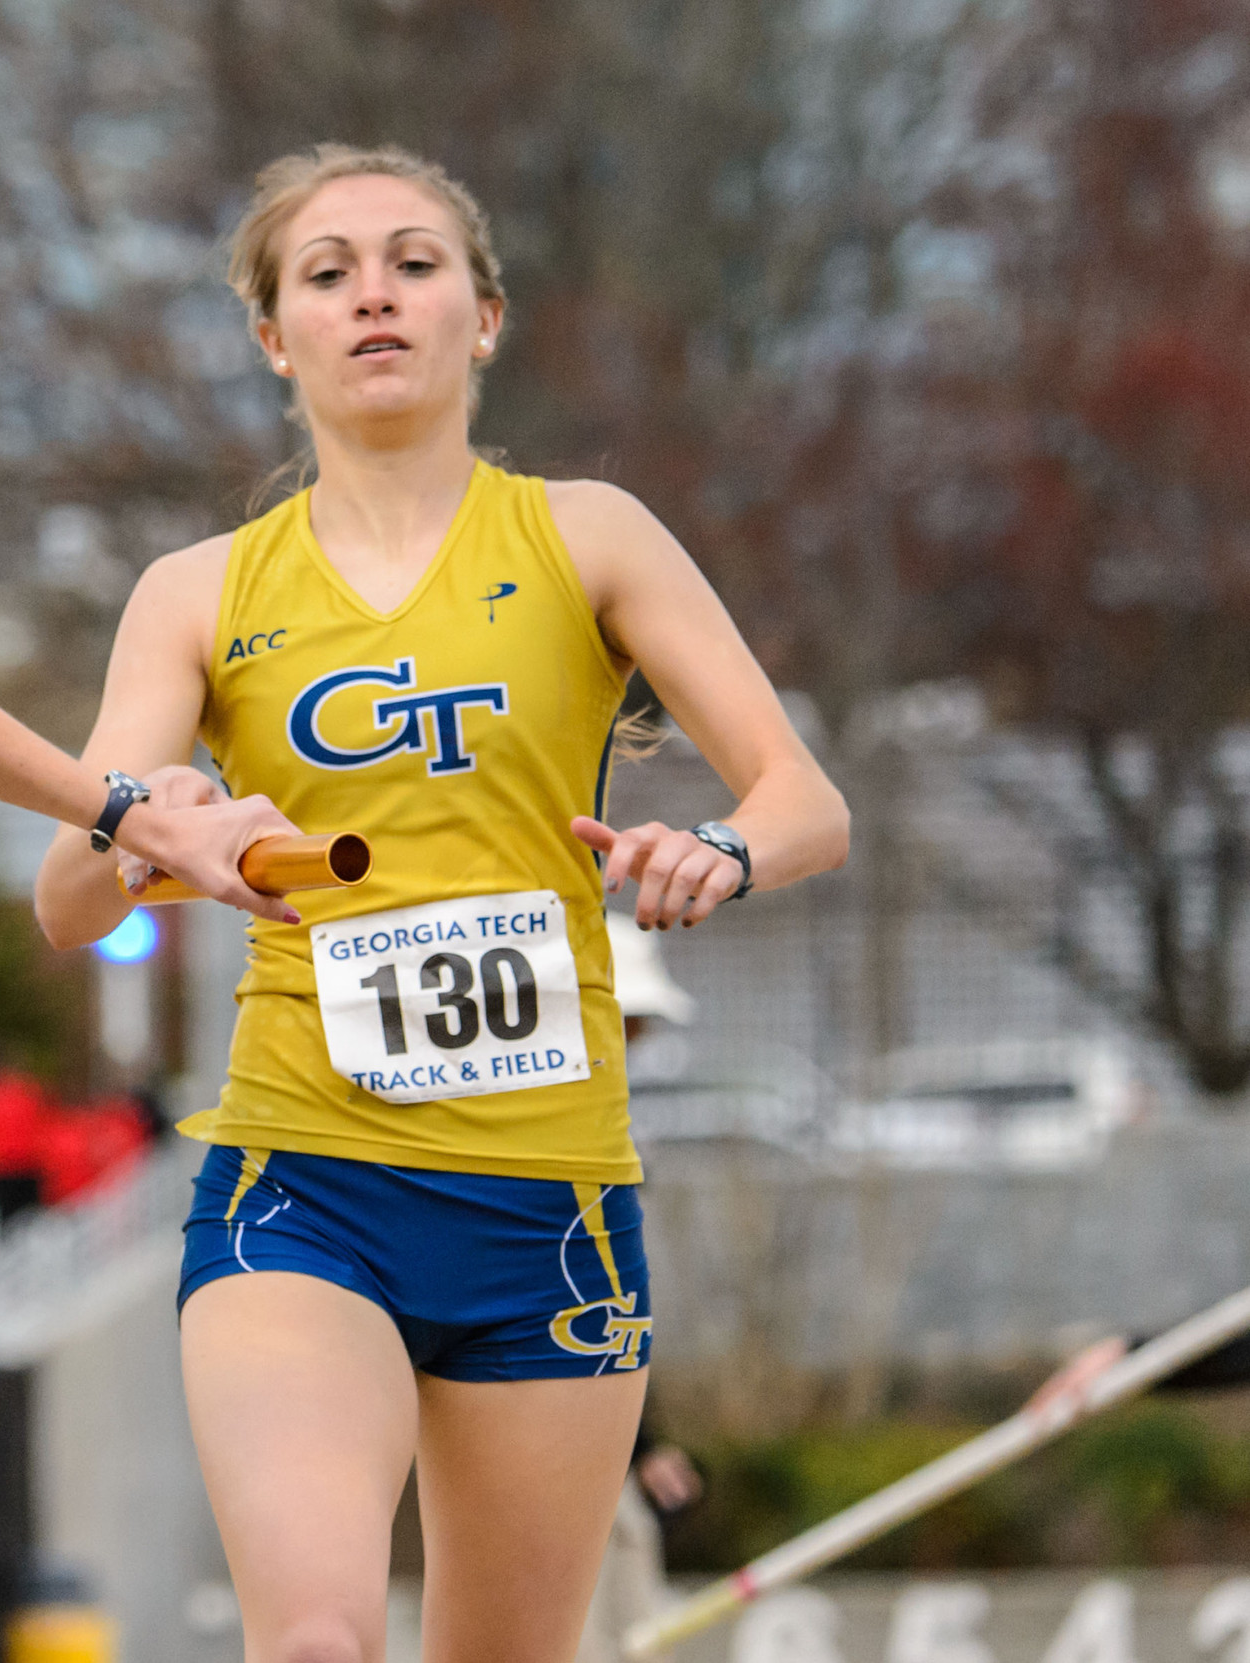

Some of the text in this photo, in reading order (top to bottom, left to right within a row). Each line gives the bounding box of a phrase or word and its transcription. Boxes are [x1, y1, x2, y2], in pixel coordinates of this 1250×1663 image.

[225, 629, 287, 663] ACC
[286, 656, 510, 777] GT
[330, 912, 547, 960] GEORGIA TECH
[360, 947, 538, 1057] 130
[352, 1064, 447, 1091] TRACK
[460, 1061, 479, 1081] &
[491, 1049, 565, 1077] FIELD
[549, 1291, 652, 1369] GT
